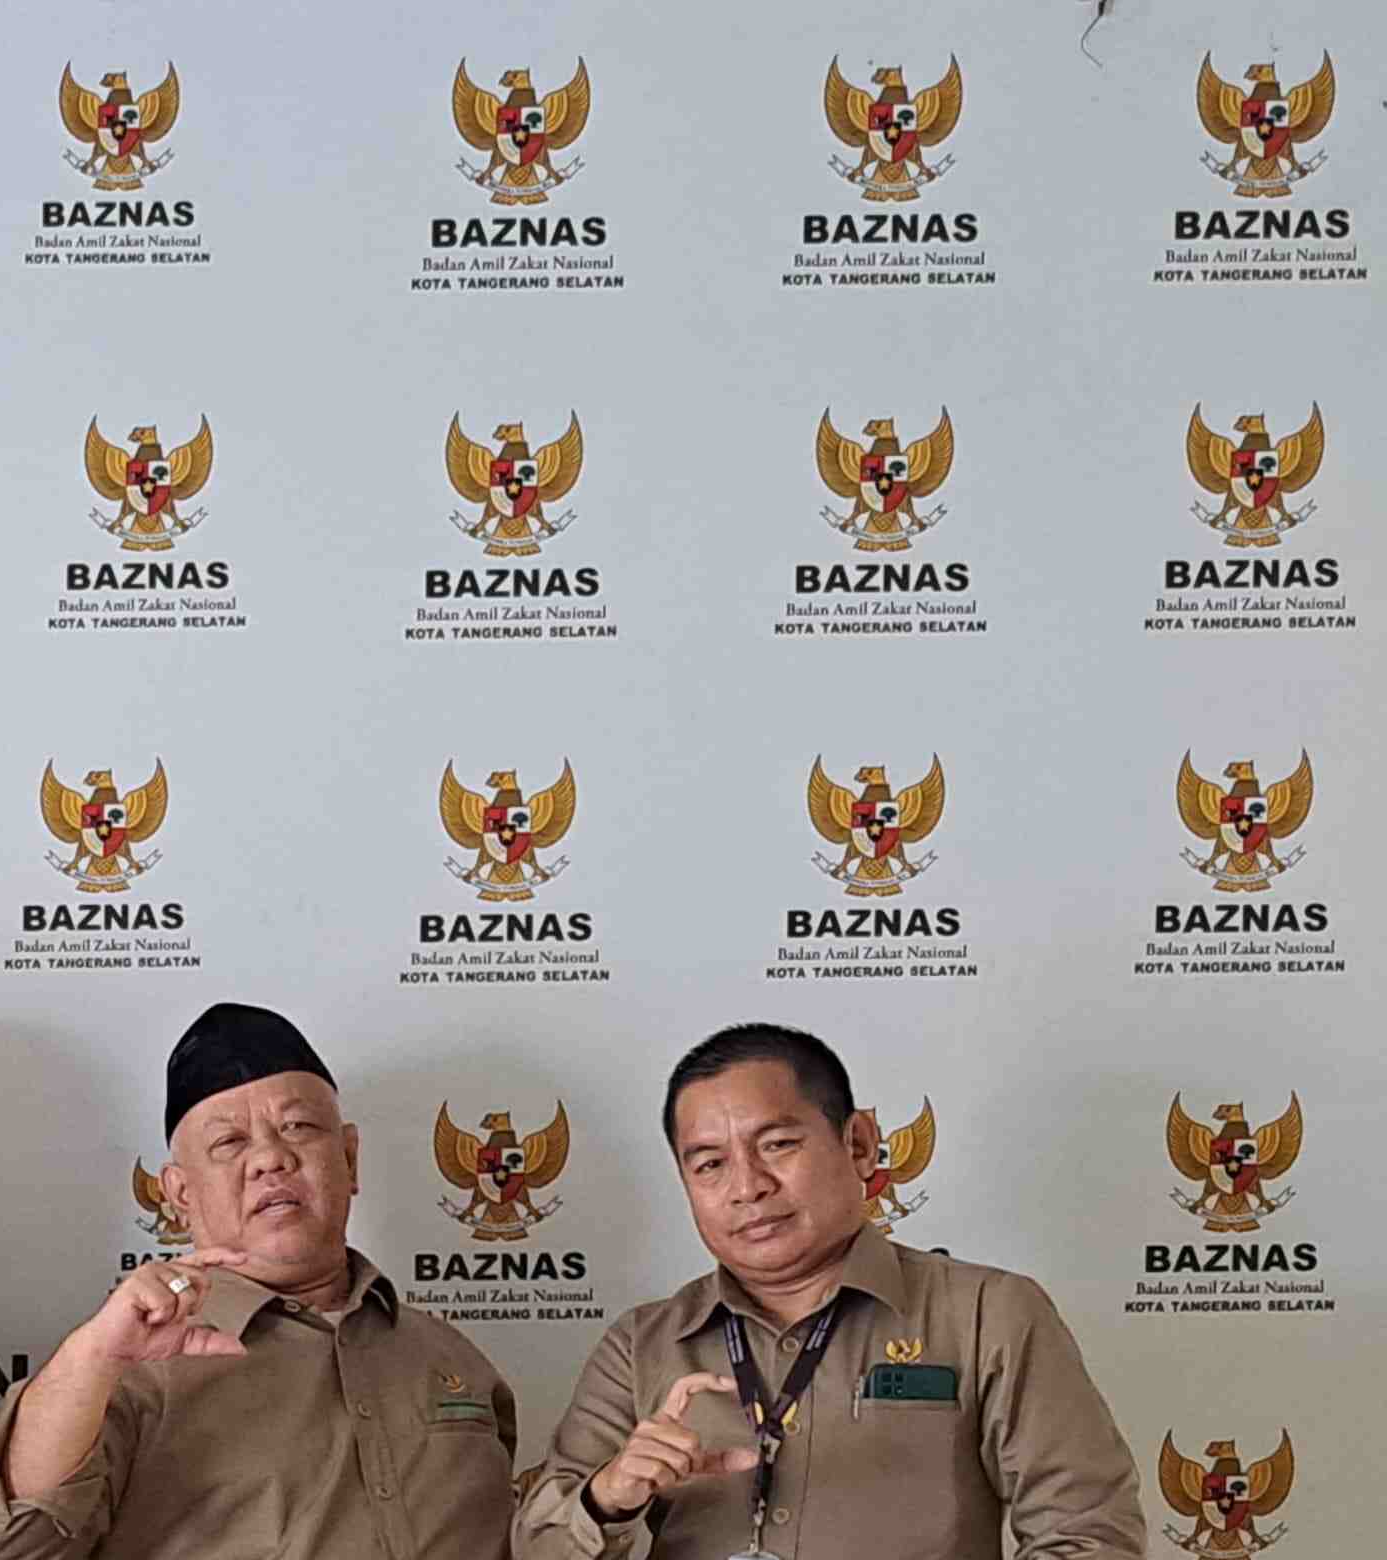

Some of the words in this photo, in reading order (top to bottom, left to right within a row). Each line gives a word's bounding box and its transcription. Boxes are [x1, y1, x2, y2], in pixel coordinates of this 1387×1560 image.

[803, 214, 977, 244] BAZNAS
[794, 253, 837, 267] Badan
[841, 253, 875, 266] Amil
[880, 253, 919, 266] Zakat
[924, 252, 985, 265] Nasional
[782, 274, 822, 285] KOTA
[829, 274, 921, 284] TANGERANG
[928, 272, 995, 284] SELATAN
